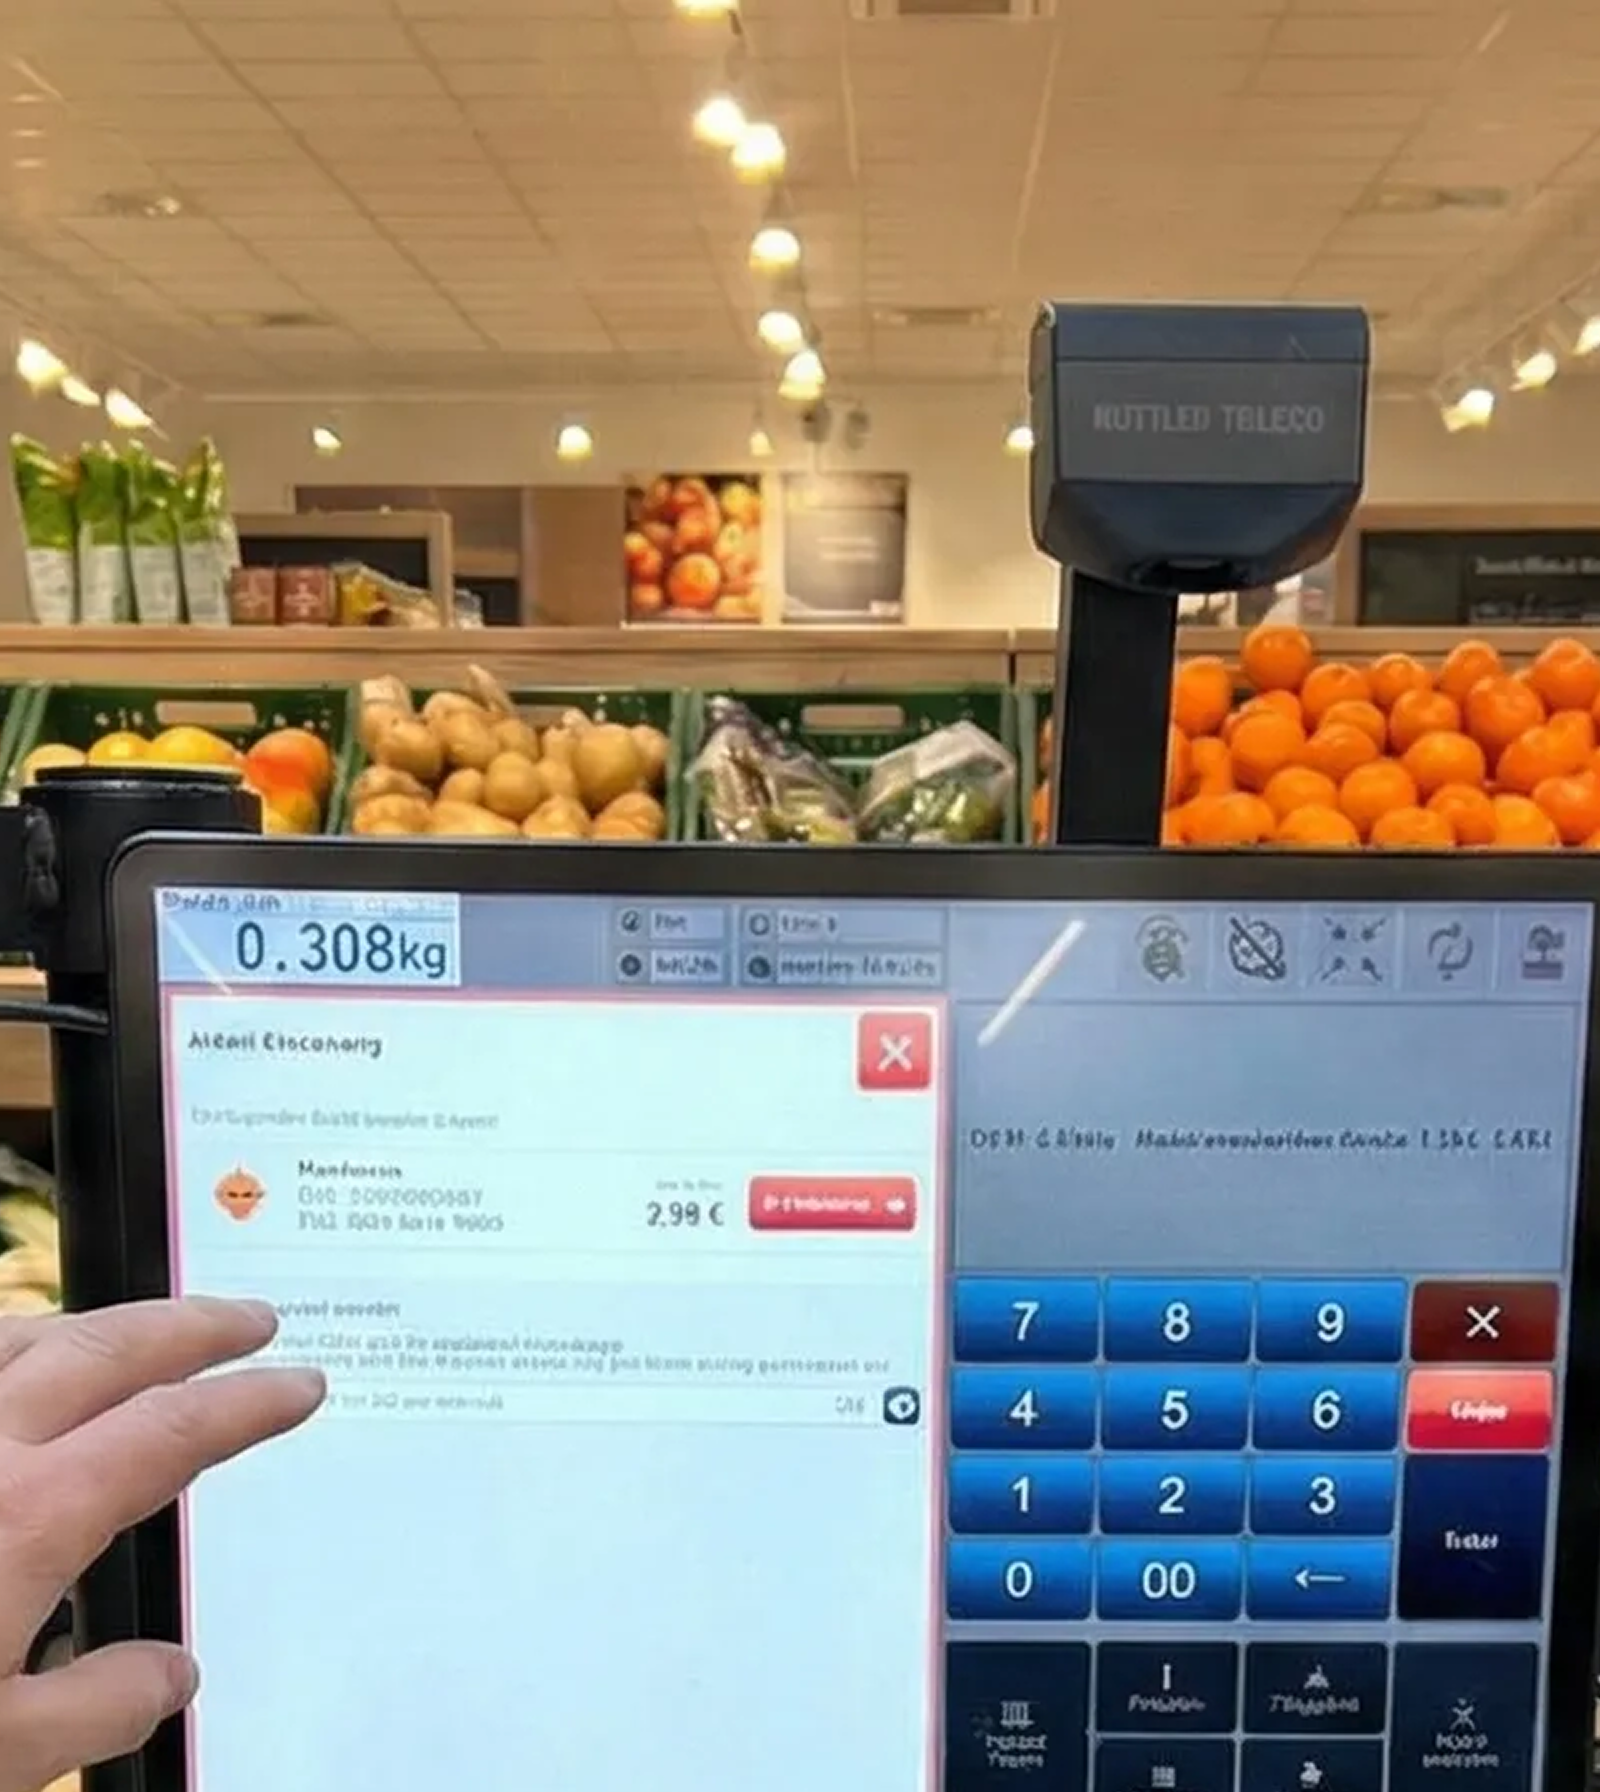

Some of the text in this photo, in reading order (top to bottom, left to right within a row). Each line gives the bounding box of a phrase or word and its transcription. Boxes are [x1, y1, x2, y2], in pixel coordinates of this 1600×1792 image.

[237, 921, 445, 979] 0.308kg
[1013, 1301, 1039, 1340] 7
[1165, 1303, 1189, 1341] 8
[1318, 1303, 1343, 1341] 9
[1011, 1390, 1037, 1426] 4
[1163, 1390, 1188, 1429] 5
[1314, 1390, 1340, 1428] 6
[1013, 1477, 1028, 1511] 1
[1160, 1476, 1184, 1513] 2
[1311, 1477, 1335, 1513] 3
[1007, 1562, 1032, 1597] 0
[1143, 1562, 1195, 1598] 00
